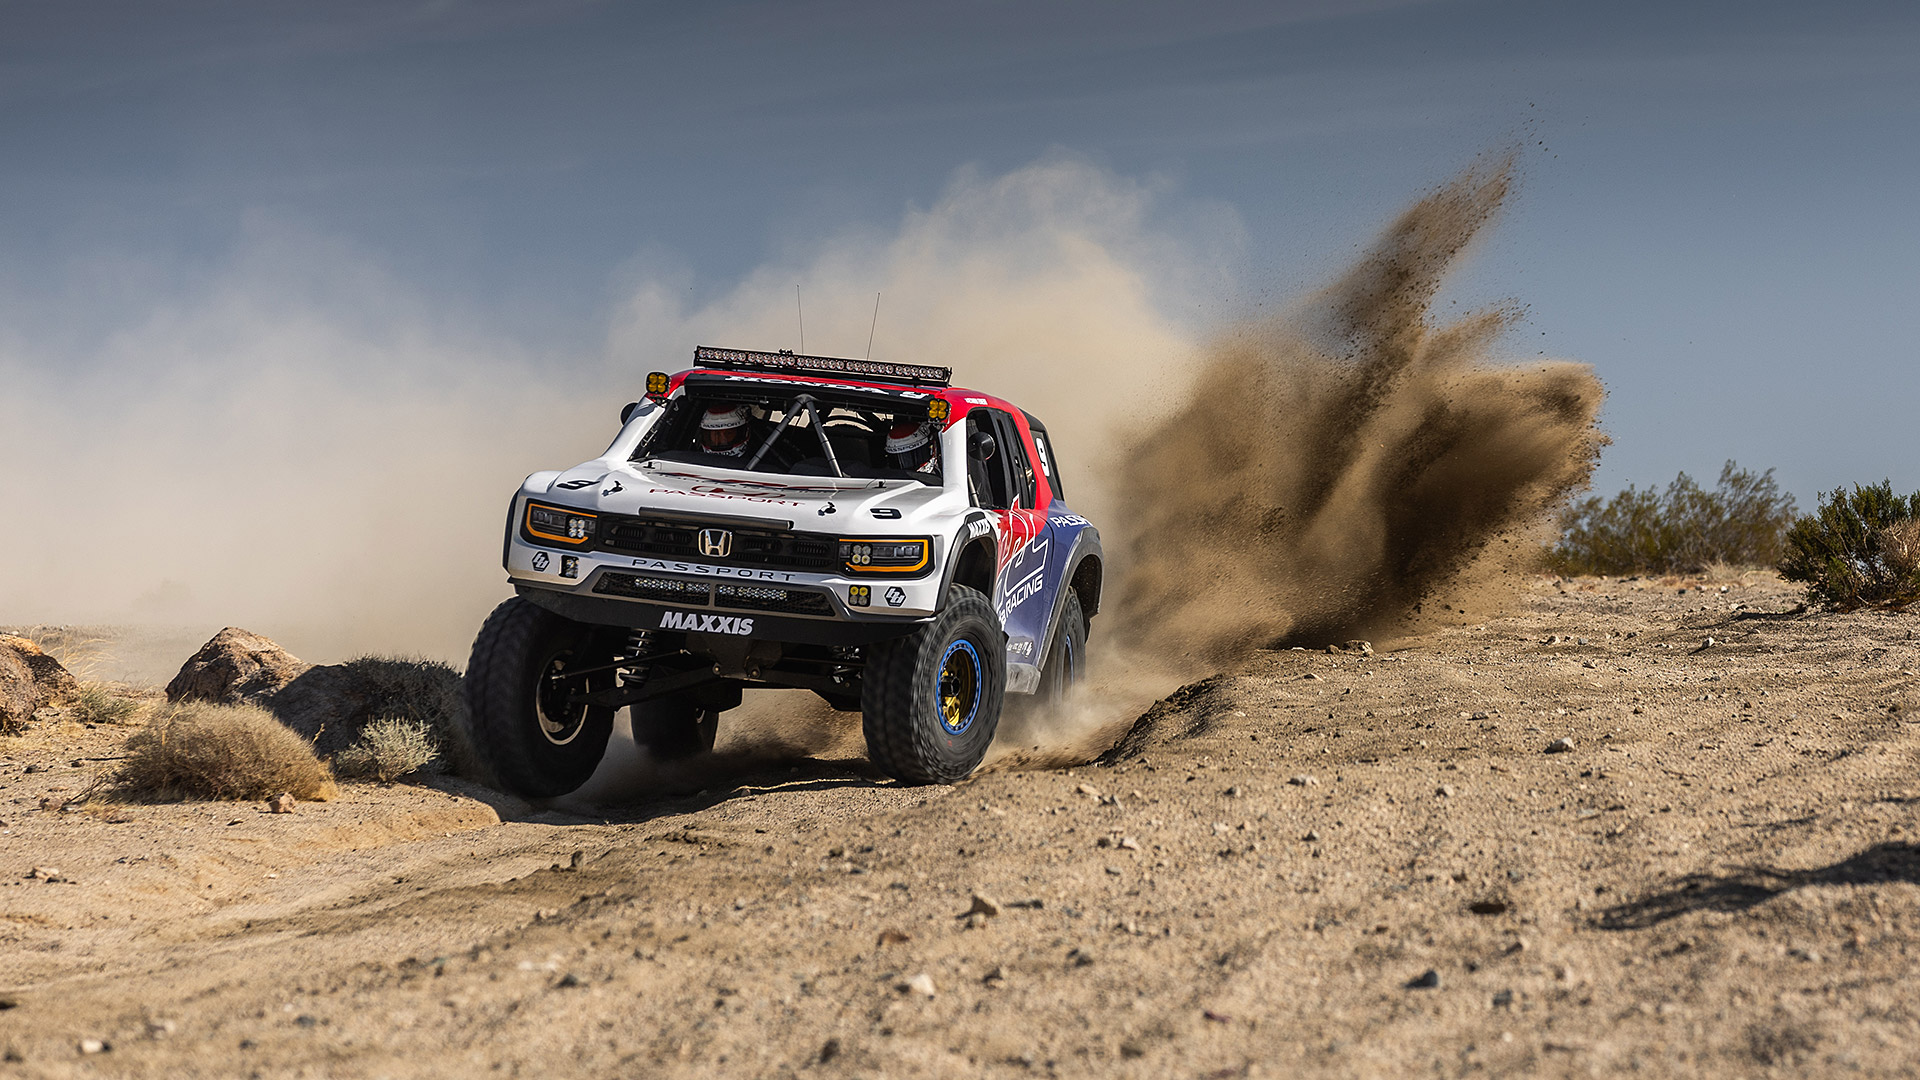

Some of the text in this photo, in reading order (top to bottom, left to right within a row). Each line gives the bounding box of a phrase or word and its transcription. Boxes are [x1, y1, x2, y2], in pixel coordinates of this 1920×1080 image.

[1036, 437, 1051, 477] 9
[649, 488, 806, 506] PASSPORT
[869, 507, 902, 519] 9
[632, 558, 796, 582] PASSPORT
[1005, 573, 1043, 618] RACING
[659, 611, 754, 636] MAXXIS
